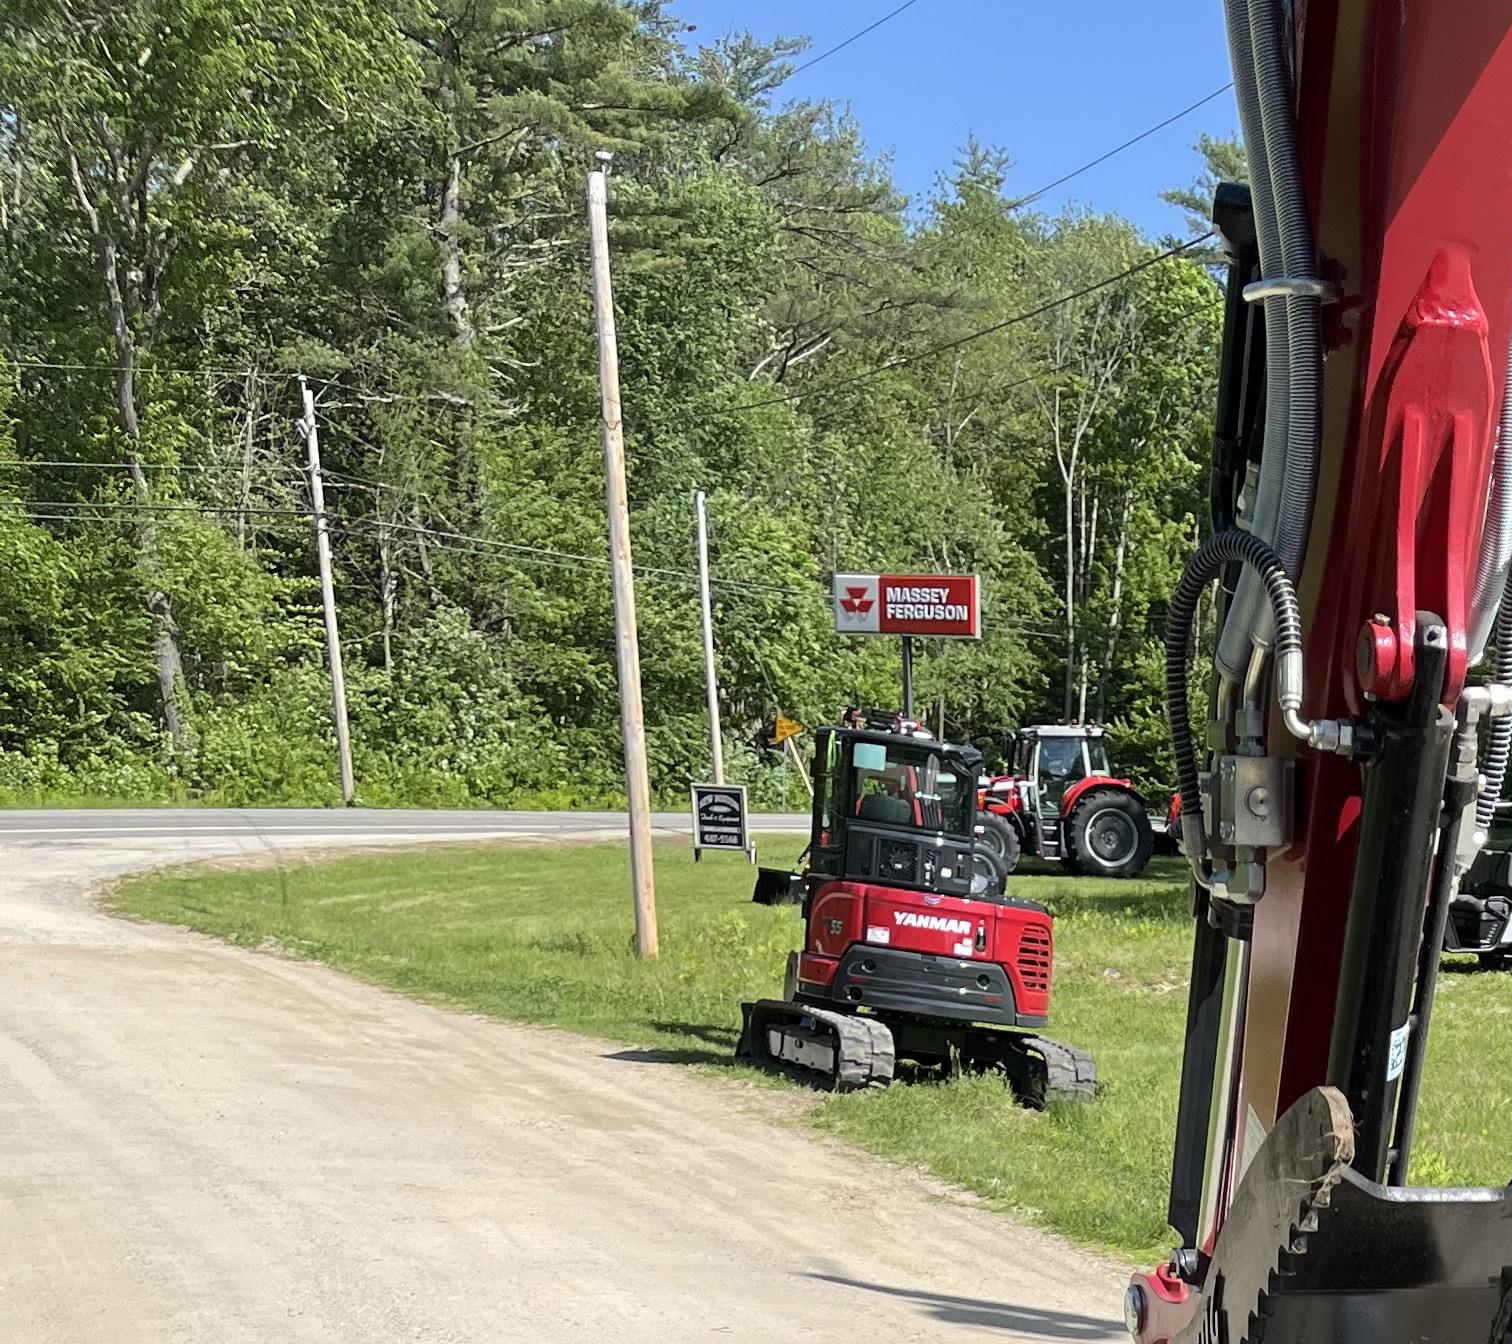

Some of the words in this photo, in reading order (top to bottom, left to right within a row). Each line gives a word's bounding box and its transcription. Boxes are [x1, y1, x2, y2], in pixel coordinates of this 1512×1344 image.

[886, 587, 949, 603] MASSEY
[886, 604, 968, 620] FERGUSON
[893, 911, 972, 934] YANMAR
